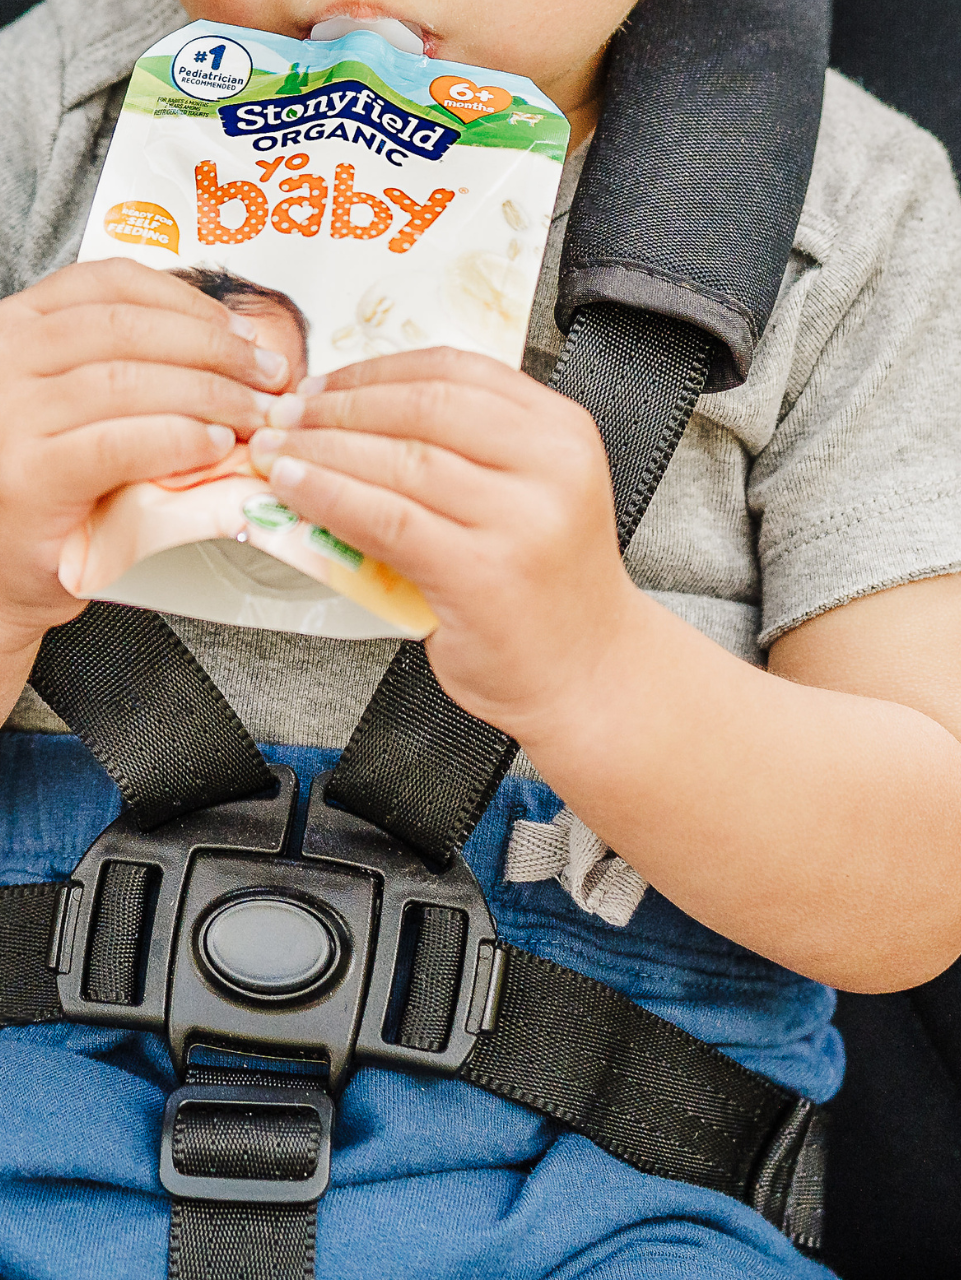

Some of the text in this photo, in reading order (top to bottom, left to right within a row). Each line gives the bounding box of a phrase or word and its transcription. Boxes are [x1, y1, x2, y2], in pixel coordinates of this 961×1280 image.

[193, 44, 226, 71] #1
[179, 66, 244, 85] Pediatrician
[181, 77, 236, 91] RECOMMENDED
[449, 83, 494, 102] 6+
[444, 99, 495, 113] months
[236, 89, 445, 151] Stonyfield
[252, 121, 409, 167] ORGANIC
[194, 160, 455, 254] baby
[122, 208, 173, 226] READY FOR
[126, 216, 161, 229] SELF
[107, 222, 169, 244] FEEDING
